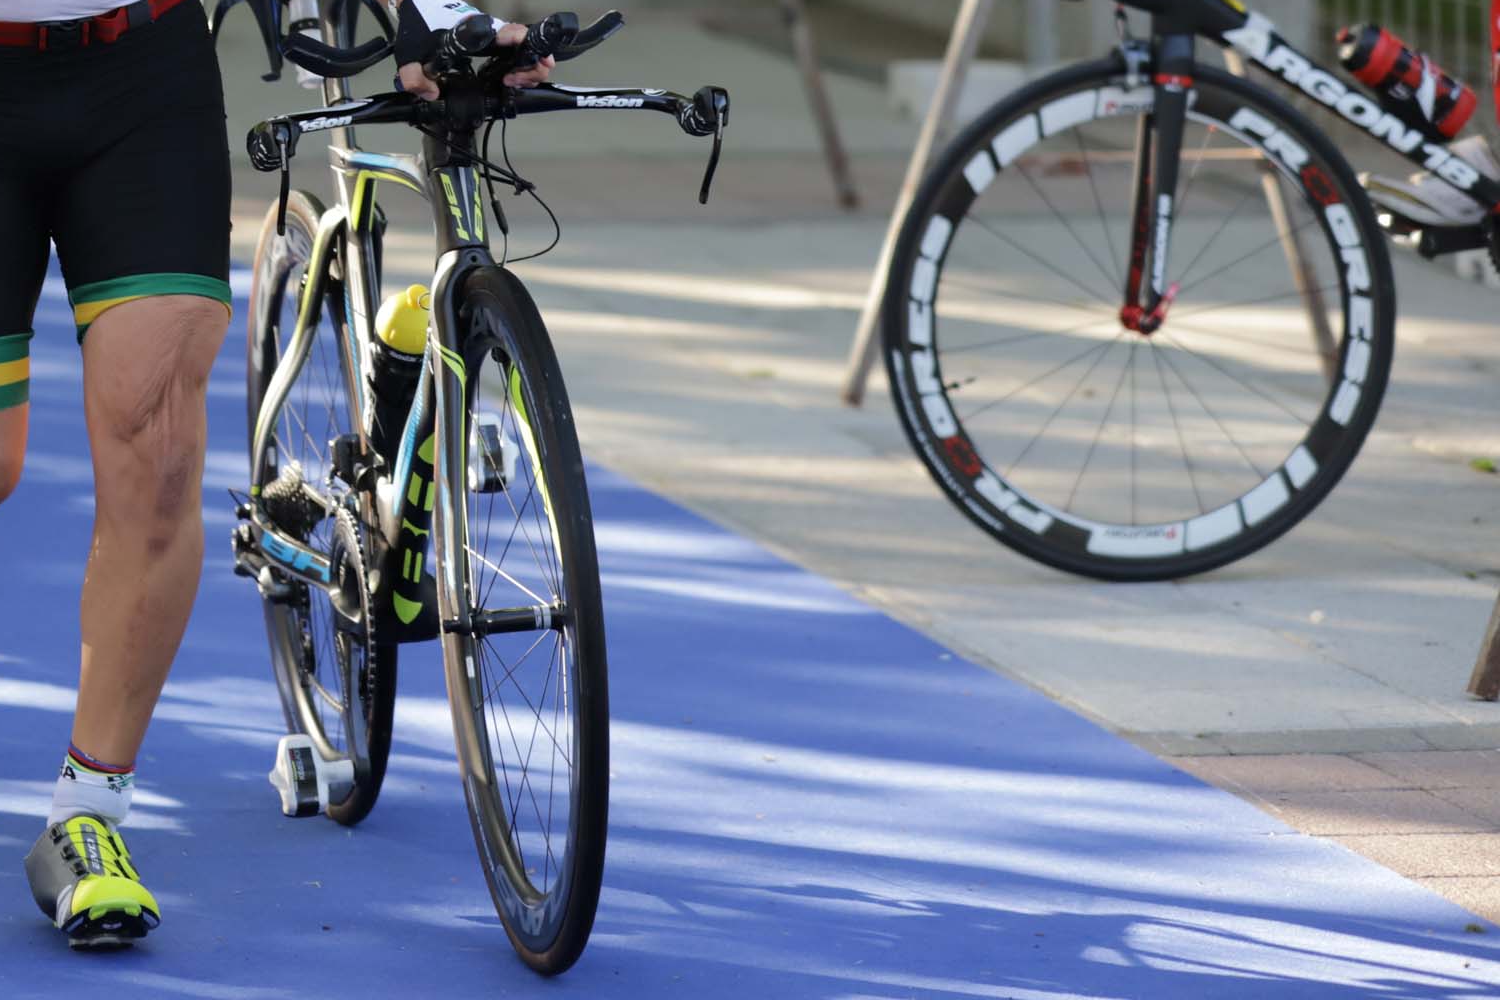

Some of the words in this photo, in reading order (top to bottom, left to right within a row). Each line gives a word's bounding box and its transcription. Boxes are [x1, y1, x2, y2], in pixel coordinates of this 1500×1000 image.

[1221, 10, 1424, 154] ARGON
[1421, 142, 1481, 191] 18
[1229, 108, 1375, 426] PROGRESS
